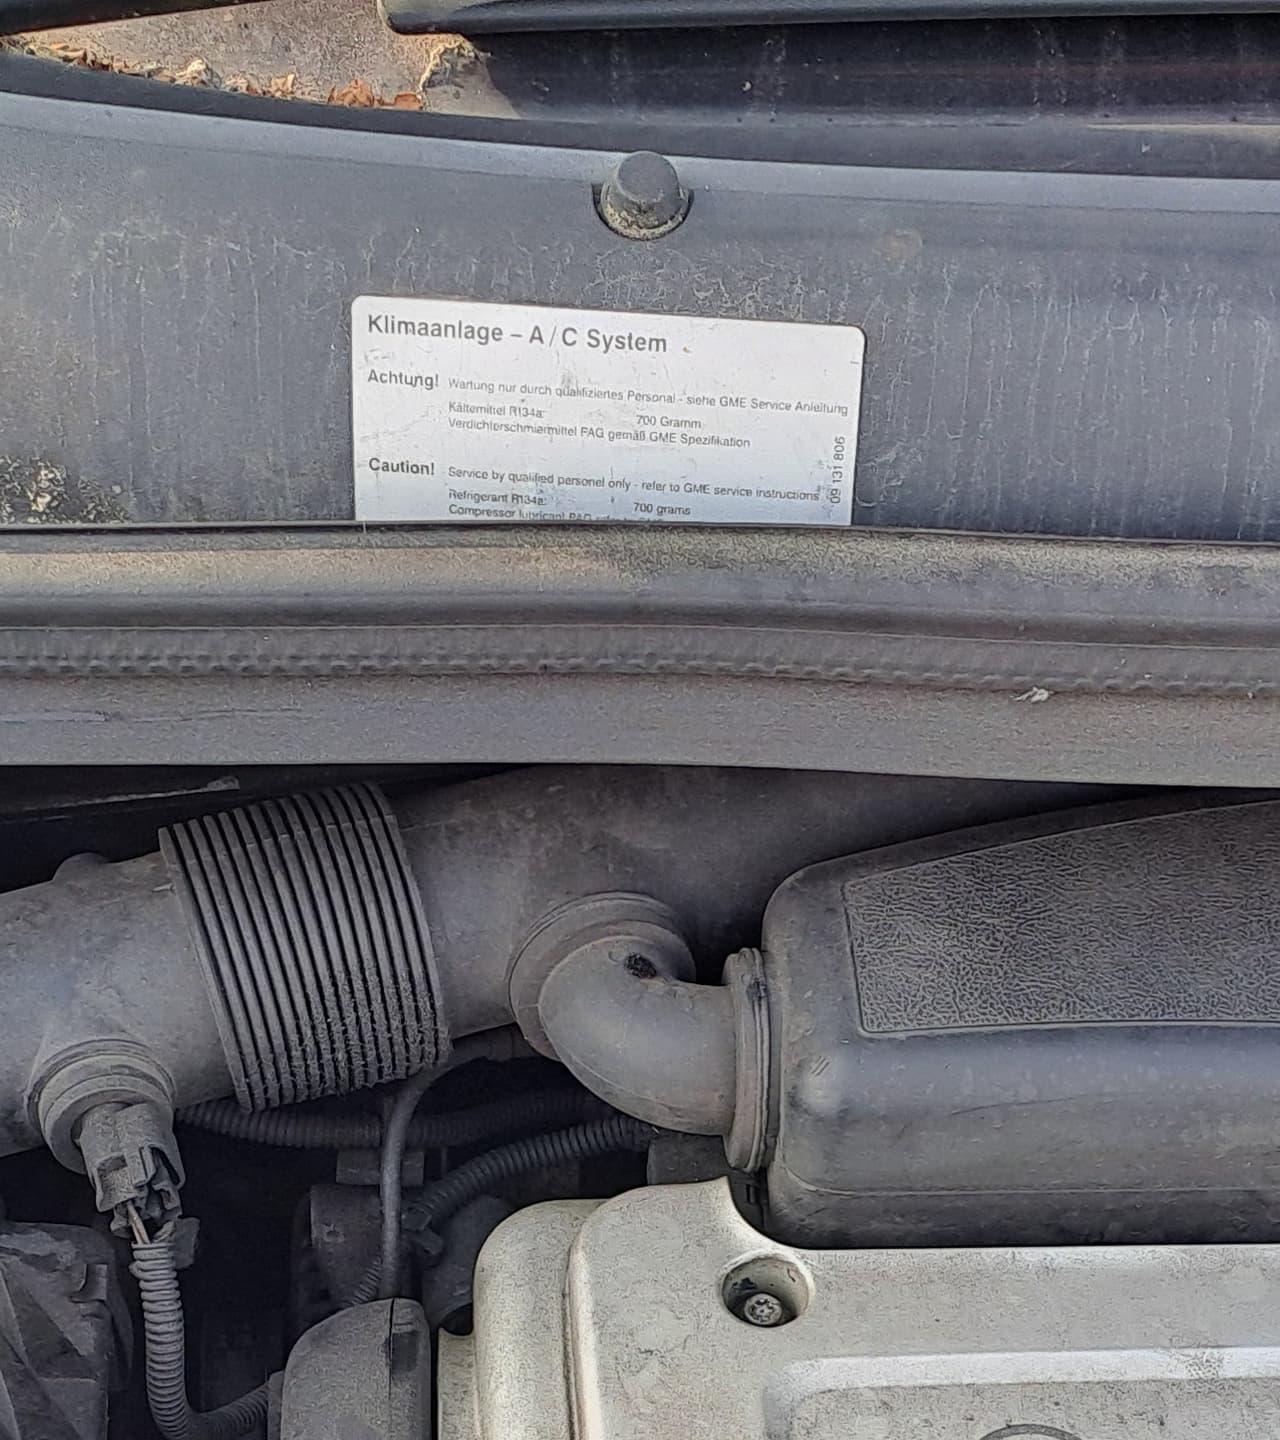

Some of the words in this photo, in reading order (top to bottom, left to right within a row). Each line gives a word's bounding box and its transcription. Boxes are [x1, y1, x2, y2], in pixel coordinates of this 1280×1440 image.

[368, 314, 503, 346] Klimaanlage
[586, 328, 667, 354] System
[368, 369, 439, 390] Achtung!
[448, 377, 495, 394] Wartung
[498, 383, 516, 393] nur
[520, 383, 552, 395] durch
[556, 385, 624, 401] qualifiziertes
[627, 390, 676, 404] Personal
[686, 395, 716, 407] siehe
[719, 395, 747, 408] GME
[750, 398, 792, 412] Service
[795, 401, 849, 417] Anleitung
[448, 401, 506, 416] Kältemittel
[636, 415, 657, 426] 700
[660, 416, 702, 429] Gramm
[448, 417, 578, 437] Verdichterschmiermittel
[581, 427, 605, 438] PAG
[608, 430, 646, 442] gemäß
[649, 431, 677, 443] GME
[680, 433, 750, 448] Spezifikation
[833, 435, 845, 461] 806
[369, 457, 435, 475] Caution!
[448, 466, 488, 479] Service
[492, 470, 505, 483] by
[508, 472, 554, 485] qualified
[557, 474, 605, 488] personel
[608, 478, 631, 492] only
[642, 481, 666, 492] refer
[669, 483, 680, 492] to
[683, 483, 710, 494] GME
[713, 486, 753, 497] service
[756, 487, 820, 501] instructions
[448, 488, 507, 503] Refrigerant
[633, 502, 653, 513] 700
[656, 505, 691, 517] grams
[448, 504, 516, 518] Compressor
